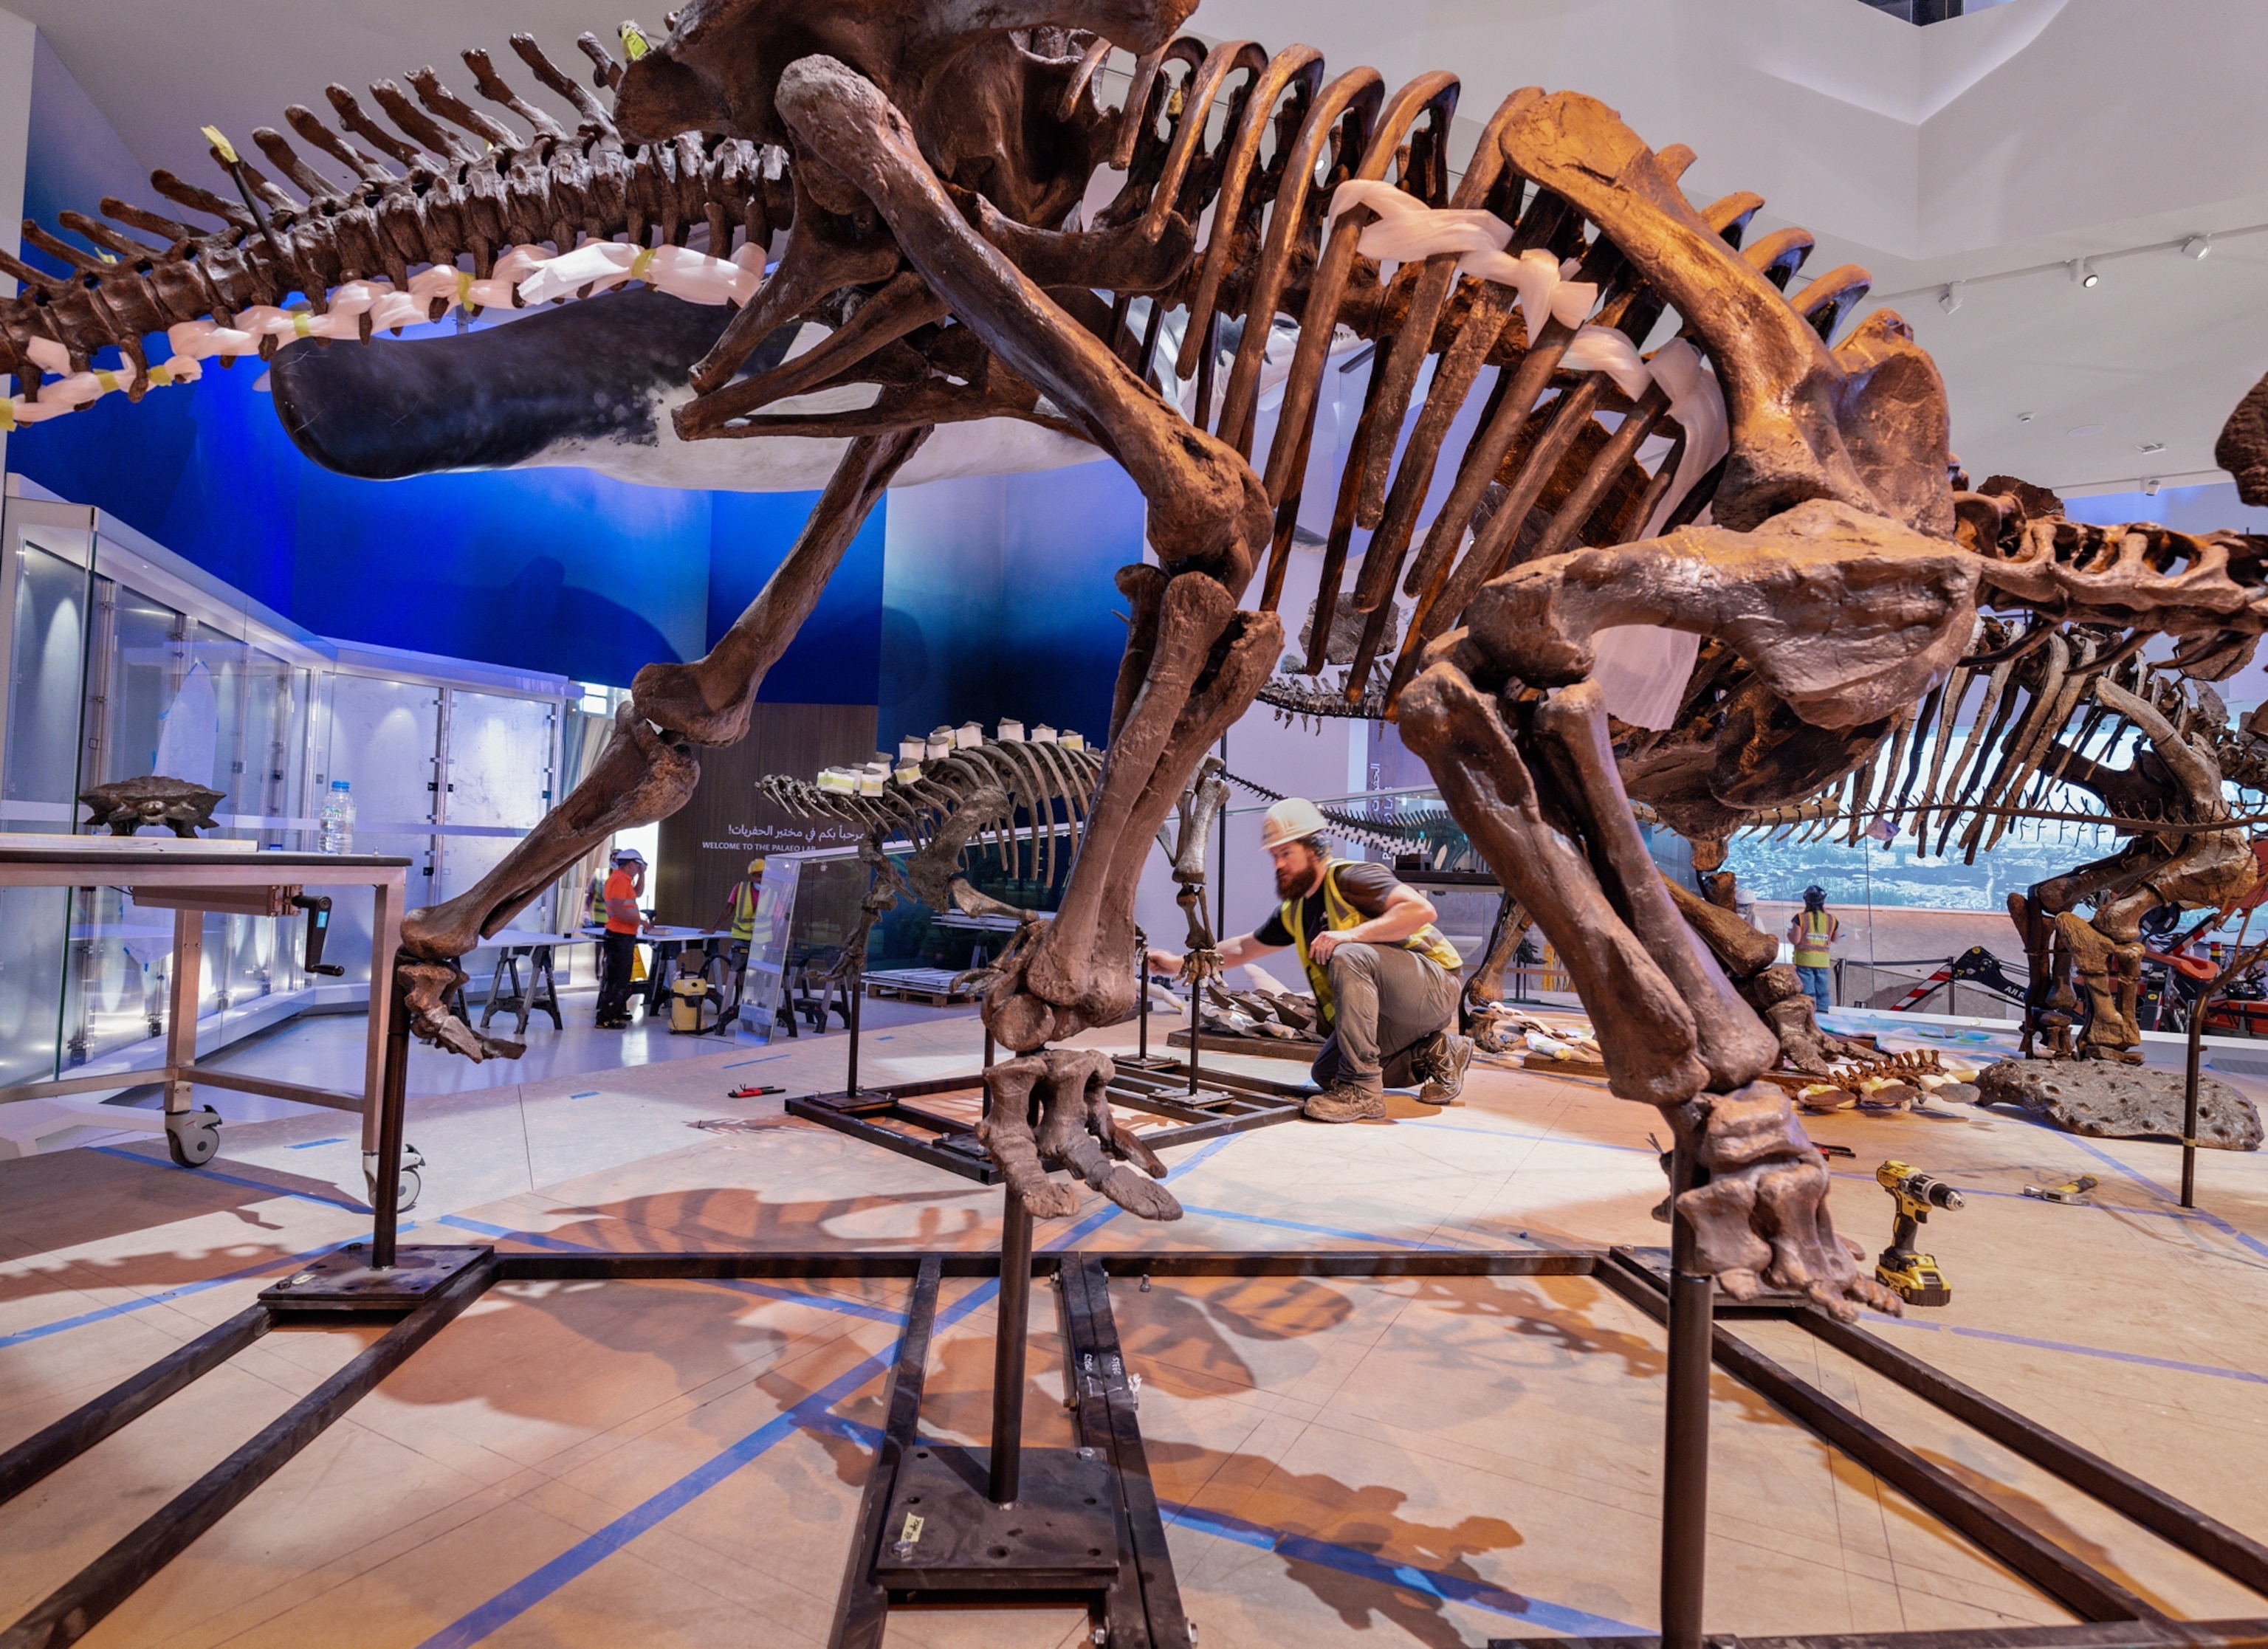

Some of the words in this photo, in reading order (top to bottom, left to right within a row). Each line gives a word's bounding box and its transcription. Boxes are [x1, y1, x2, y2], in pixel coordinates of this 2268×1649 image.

[775, 827, 803, 839] مختبر
[805, 827, 815, 841] في
[819, 827, 835, 841] بكم
[702, 841, 740, 850] WELCOME
[772, 844, 800, 853] PALAEO
